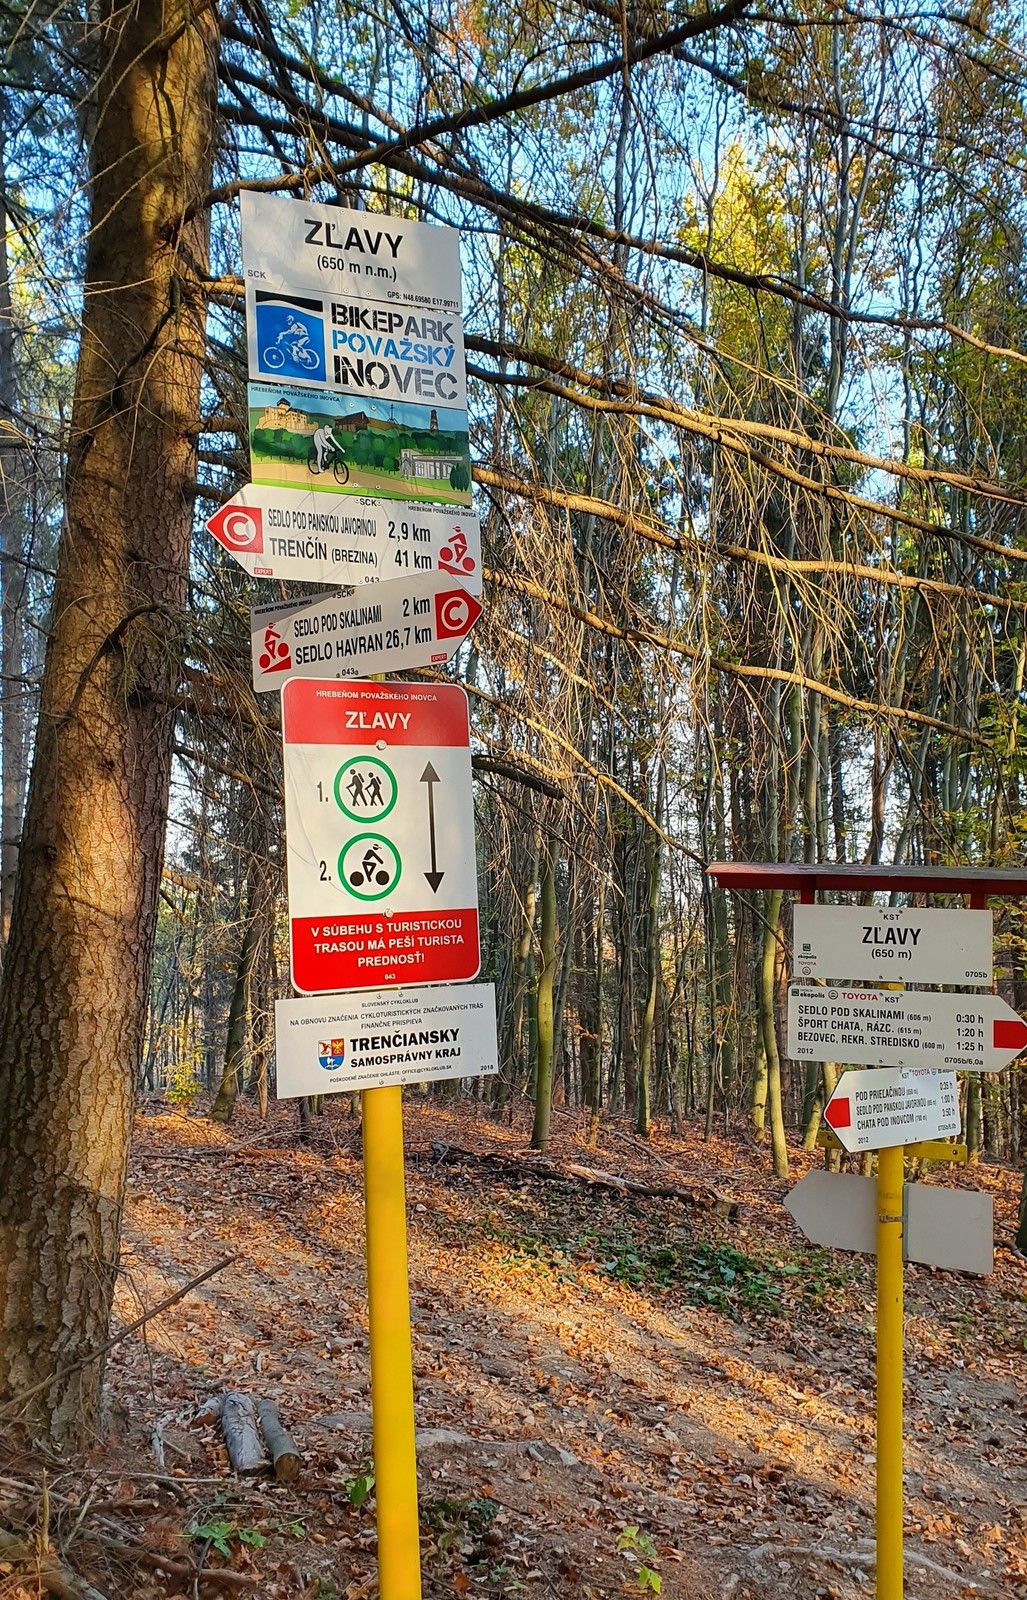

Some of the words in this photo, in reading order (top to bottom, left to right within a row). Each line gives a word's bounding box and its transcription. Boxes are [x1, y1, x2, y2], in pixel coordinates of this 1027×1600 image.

[304, 219, 403, 258] ZĽAVY
[247, 269, 267, 279] SCK
[317, 254, 344, 272] (650
[349, 264, 361, 274] m
[365, 266, 397, 282] n.m.)
[387, 291, 402, 299] GPS:
[331, 302, 455, 344] BIKEPARK
[332, 330, 455, 367] POVAŽSKÝ
[333, 355, 458, 400] INOVEC
[251, 386, 282, 395] HREBEŇOM
[282, 390, 319, 400] POVAŽSKÉHO
[319, 395, 340, 403] INOVCA
[360, 498, 377, 507] SCK
[268, 508, 291, 529] SEDLO
[293, 512, 308, 530] POD
[308, 514, 339, 534] PANSKOU
[340, 517, 377, 537] JAVORINOU
[388, 521, 409, 541] 2,9
[412, 522, 431, 543] km
[269, 536, 327, 561] TRENČÍN
[331, 549, 378, 568] (BREZINA)
[395, 550, 409, 569] 41
[413, 550, 432, 569] km
[337, 591, 352, 599] SCK
[294, 618, 320, 638] SEDLO
[321, 615, 338, 633] POD
[339, 605, 382, 629] SKALINAMI
[403, 598, 409, 618] 2
[413, 597, 430, 616] km
[295, 641, 333, 665] SEDLO
[336, 633, 383, 658] HAVRAN
[385, 627, 410, 650] 26,7
[414, 626, 432, 644] km
[341, 668, 355, 677] 043
[316, 690, 359, 698] HREBEŇOM
[360, 692, 409, 701] POVAŽSKÉHO
[410, 694, 437, 702] INOVCA
[345, 711, 412, 730] ZĽAVY
[317, 781, 328, 802] 1.
[319, 860, 331, 881] 2.
[311, 927, 320, 937] V
[323, 923, 373, 937] SÚBEHU
[376, 923, 383, 933] S
[386, 919, 462, 933] TURISTICKOU
[862, 926, 921, 945] ZĽAVY
[314, 941, 365, 954] TRASOU
[367, 939, 386, 950] MÁ
[389, 936, 415, 948] PEŠÍ
[417, 934, 464, 947] TURISTA
[358, 952, 425, 967] PREDNOSŤ!
[871, 949, 894, 959] (650
[898, 949, 912, 961] m)
[361, 1000, 389, 1008] SLOVENSKÝ
[390, 998, 419, 1006] CYKLOKLUB
[800, 991, 825, 999] ekopolis
[842, 992, 878, 1001] TOYOTA
[885, 996, 900, 1004] KST
[300, 1017, 327, 1025] OBNOVU
[328, 1013, 359, 1022] ZNAČENIA
[360, 1008, 421, 1020] CYKLOTURISTICKÝCH
[423, 1003, 468, 1014] ZNAČKOVANÝCH
[469, 1002, 484, 1010] TRÁS
[798, 1005, 828, 1016] SEDLO
[831, 1006, 850, 1017] POD
[853, 1008, 904, 1020] SKALINAMI
[920, 1013, 932, 1023] m)
[956, 1013, 976, 1023] 0:30
[978, 1015, 984, 1024] h
[361, 1020, 391, 1029] FINANČNE
[392, 1018, 422, 1027] PRISPIEVA
[798, 1016, 828, 1029] ŠPORT
[831, 1020, 863, 1032] CHATA,
[867, 1021, 894, 1033] RÁZC.
[911, 1027, 922, 1036] m)
[957, 1028, 976, 1037] 1:20
[978, 1028, 984, 1038] h
[350, 1028, 459, 1052] TRENČIANSKY
[798, 1032, 838, 1044] BEZOVEC,
[841, 1034, 868, 1045] REKR.
[871, 1036, 920, 1049] STREDISKO
[936, 1042, 945, 1051] m)
[957, 1041, 976, 1051] 1:25
[978, 1042, 984, 1052] h
[350, 1049, 432, 1068] SAMOSPRÁVNY
[435, 1047, 461, 1058] KRAJ
[797, 1047, 814, 1055] 2012
[329, 1074, 357, 1083] POŠKODENÉ
[358, 1072, 379, 1080] ZNAČENIE
[912, 1069, 930, 1077] TOYOTA
[855, 1091, 867, 1101] POD
[856, 1104, 872, 1116] SEDLO
[872, 1102, 883, 1114] POD
[884, 1101, 904, 1113] PANSKOU
[941, 1095, 950, 1104] 1:00
[950, 1094, 954, 1102] h
[857, 1119, 876, 1130] CHATA
[877, 1117, 889, 1127] POD
[890, 1113, 914, 1126] INOVCOM
